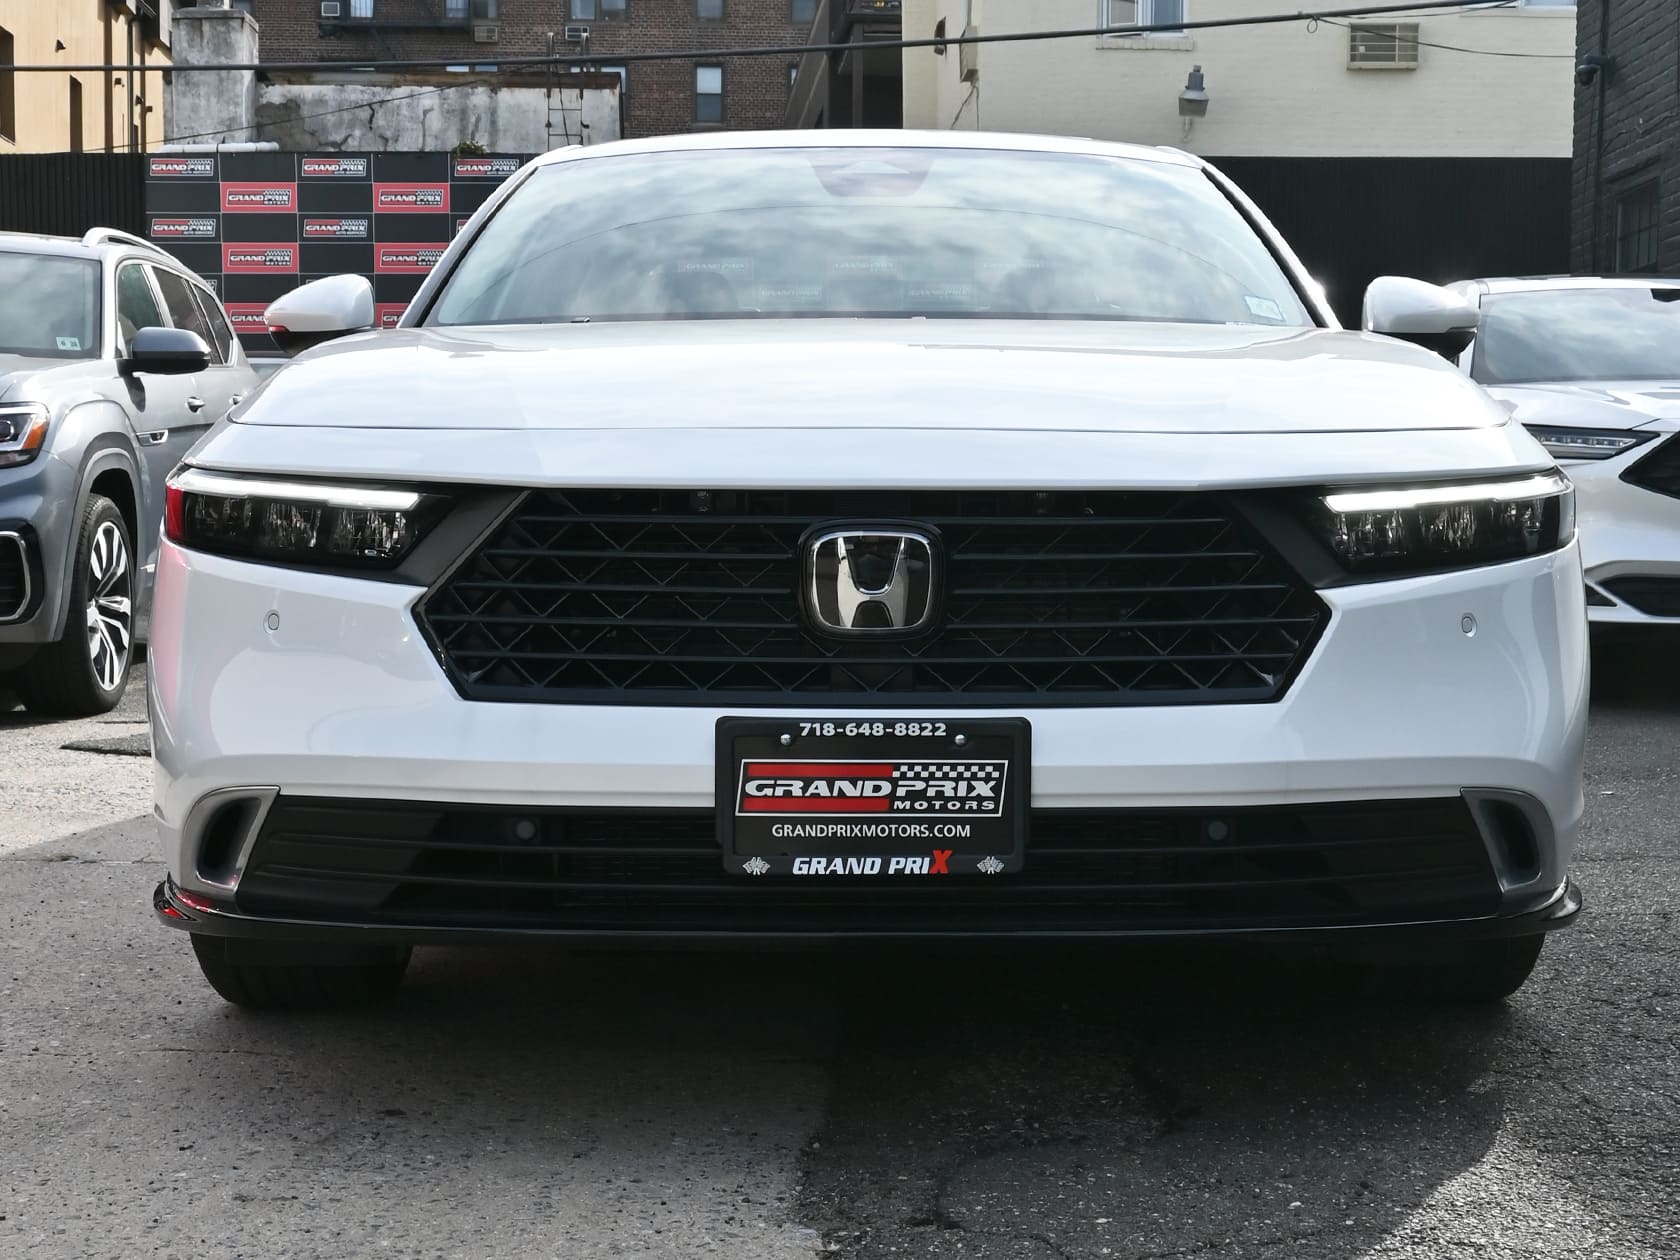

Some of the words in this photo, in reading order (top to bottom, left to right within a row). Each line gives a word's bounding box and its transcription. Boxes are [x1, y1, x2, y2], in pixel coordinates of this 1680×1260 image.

[800, 723, 947, 737] 718-648-8822
[745, 780, 892, 797] GRAND
[896, 780, 997, 798] PRIX
[893, 801, 995, 811] MOTORS
[771, 824, 971, 838] GRANDPRIXMOTORS.COM
[792, 857, 882, 875] GRAND
[888, 849, 952, 875] PRIX
